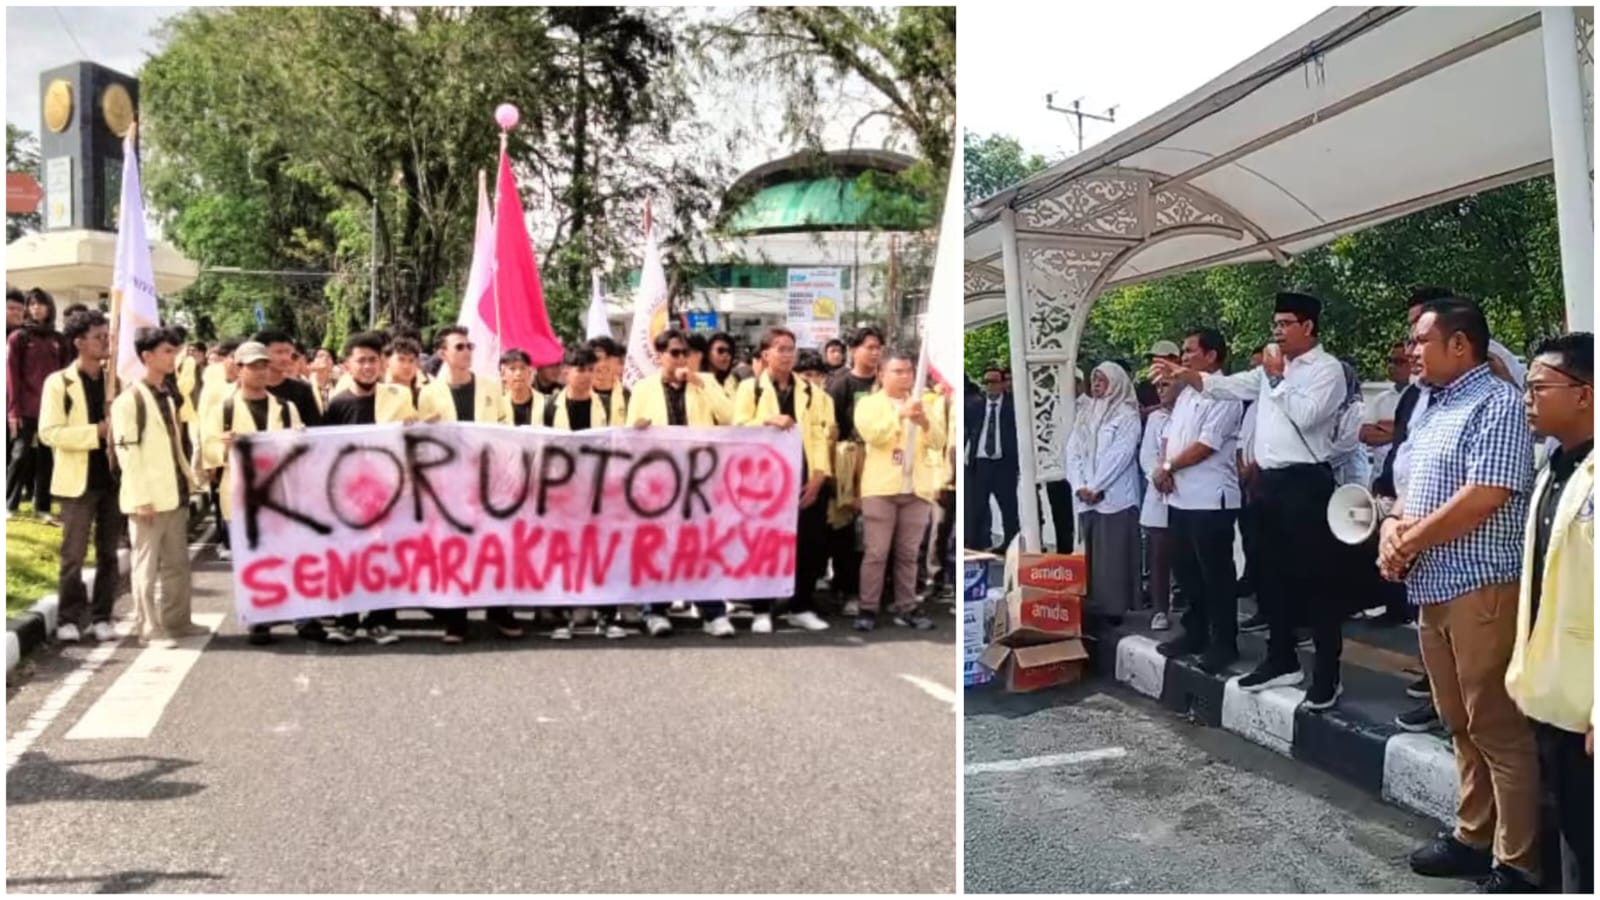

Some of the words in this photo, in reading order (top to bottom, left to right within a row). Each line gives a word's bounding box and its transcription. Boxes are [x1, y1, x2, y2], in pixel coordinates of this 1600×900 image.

[234, 433, 718, 549] KORUPTOR
[241, 518, 621, 609] SENGSARAKAN
[630, 518, 797, 588] RAKYAT
